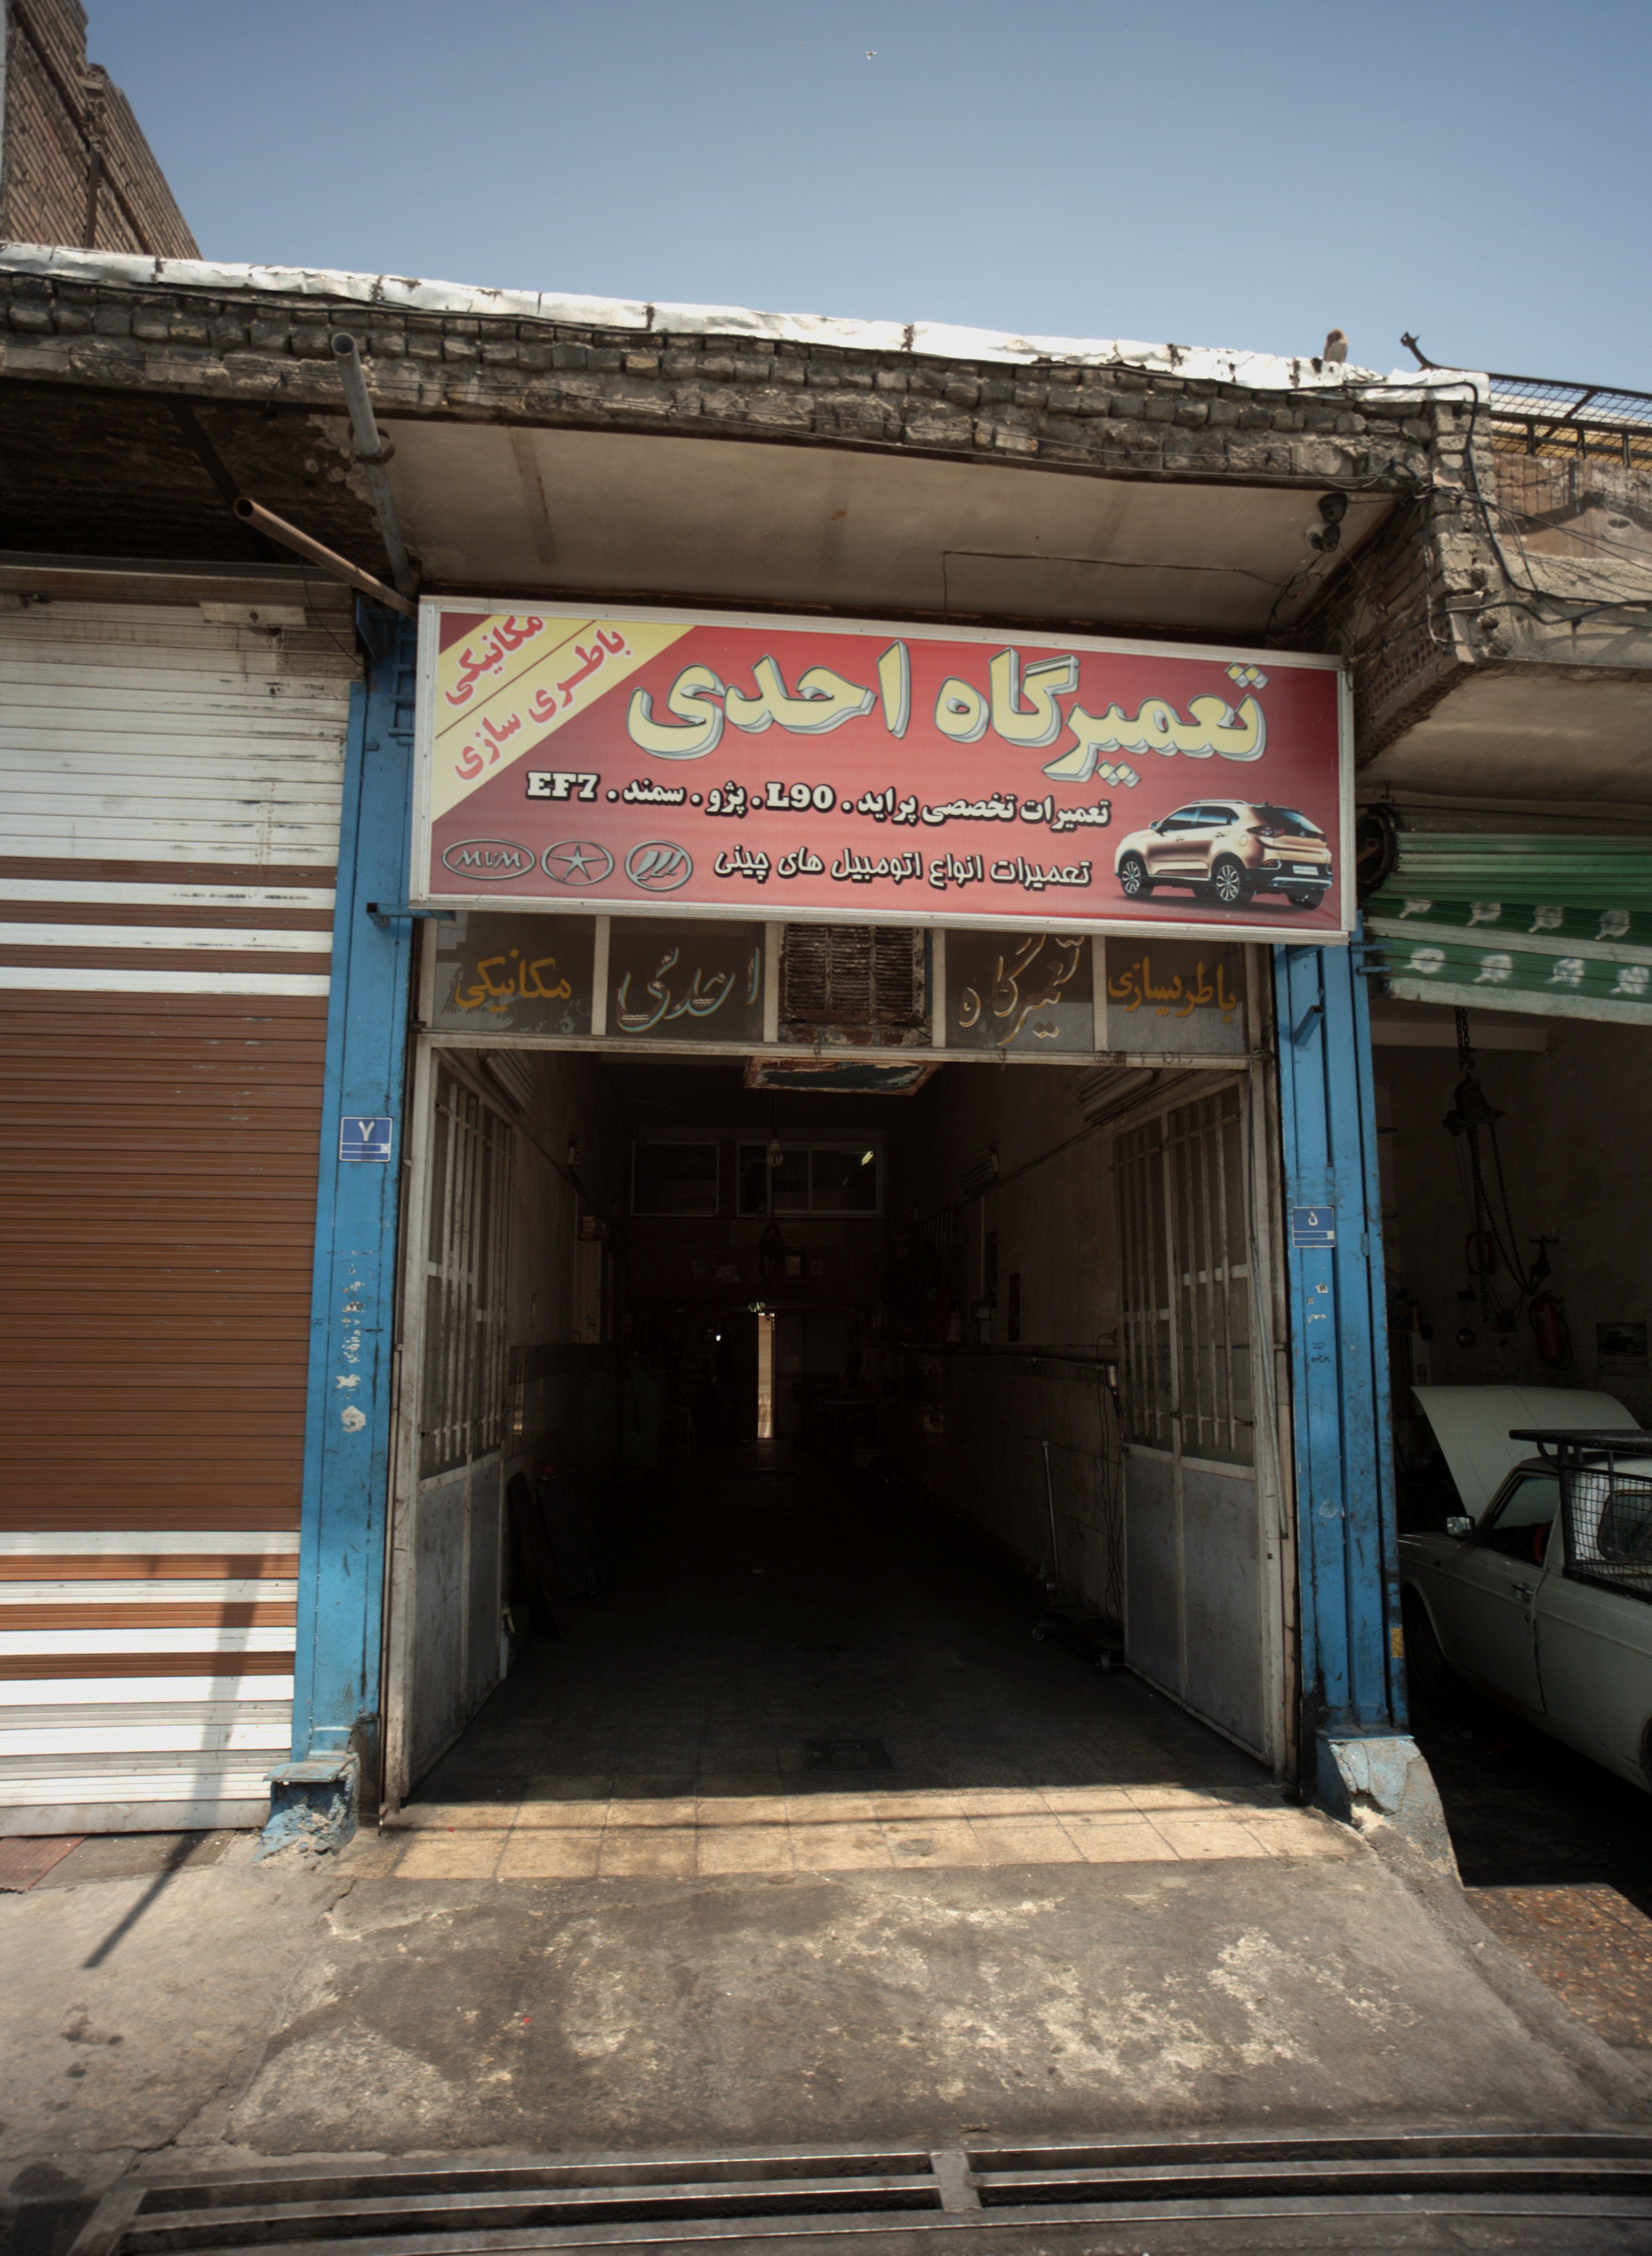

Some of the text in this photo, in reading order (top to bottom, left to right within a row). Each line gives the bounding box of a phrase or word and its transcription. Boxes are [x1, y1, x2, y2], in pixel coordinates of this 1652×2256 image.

[445, 616, 544, 706] مکانیکی
[455, 628, 631, 780] باطری سازی
[626, 639, 1269, 788] تعمیرگاه احدی
[526, 771, 1112, 832] تعمیرات تخصصی پراید L90 پژو سمند EF7
[714, 844, 1092, 891] تعمیرات انواع اتومبیل های چینی
[455, 948, 572, 1013] مکانیکی
[358, 1121, 375, 1142] ۷
